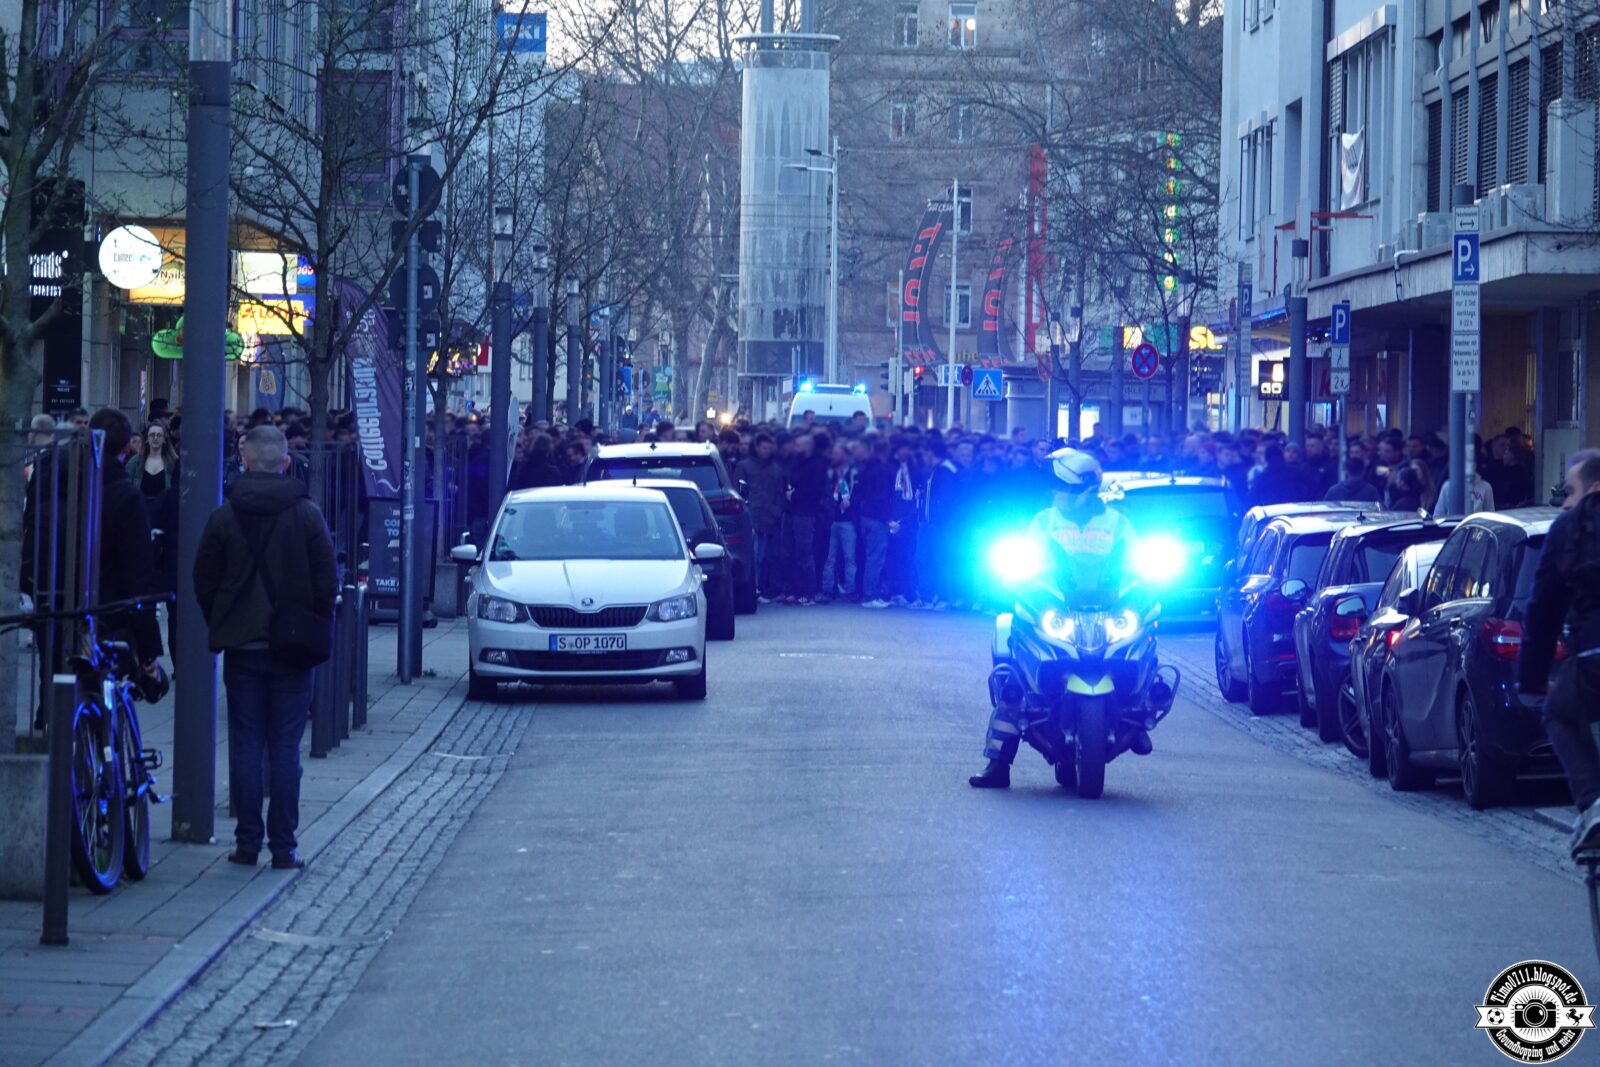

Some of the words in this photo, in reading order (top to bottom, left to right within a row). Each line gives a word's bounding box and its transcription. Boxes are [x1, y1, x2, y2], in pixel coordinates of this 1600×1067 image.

[1458, 240, 1472, 276] P
[1336, 309, 1346, 340] P
[376, 578, 396, 586] TAKE
[593, 636, 624, 649] 1070
